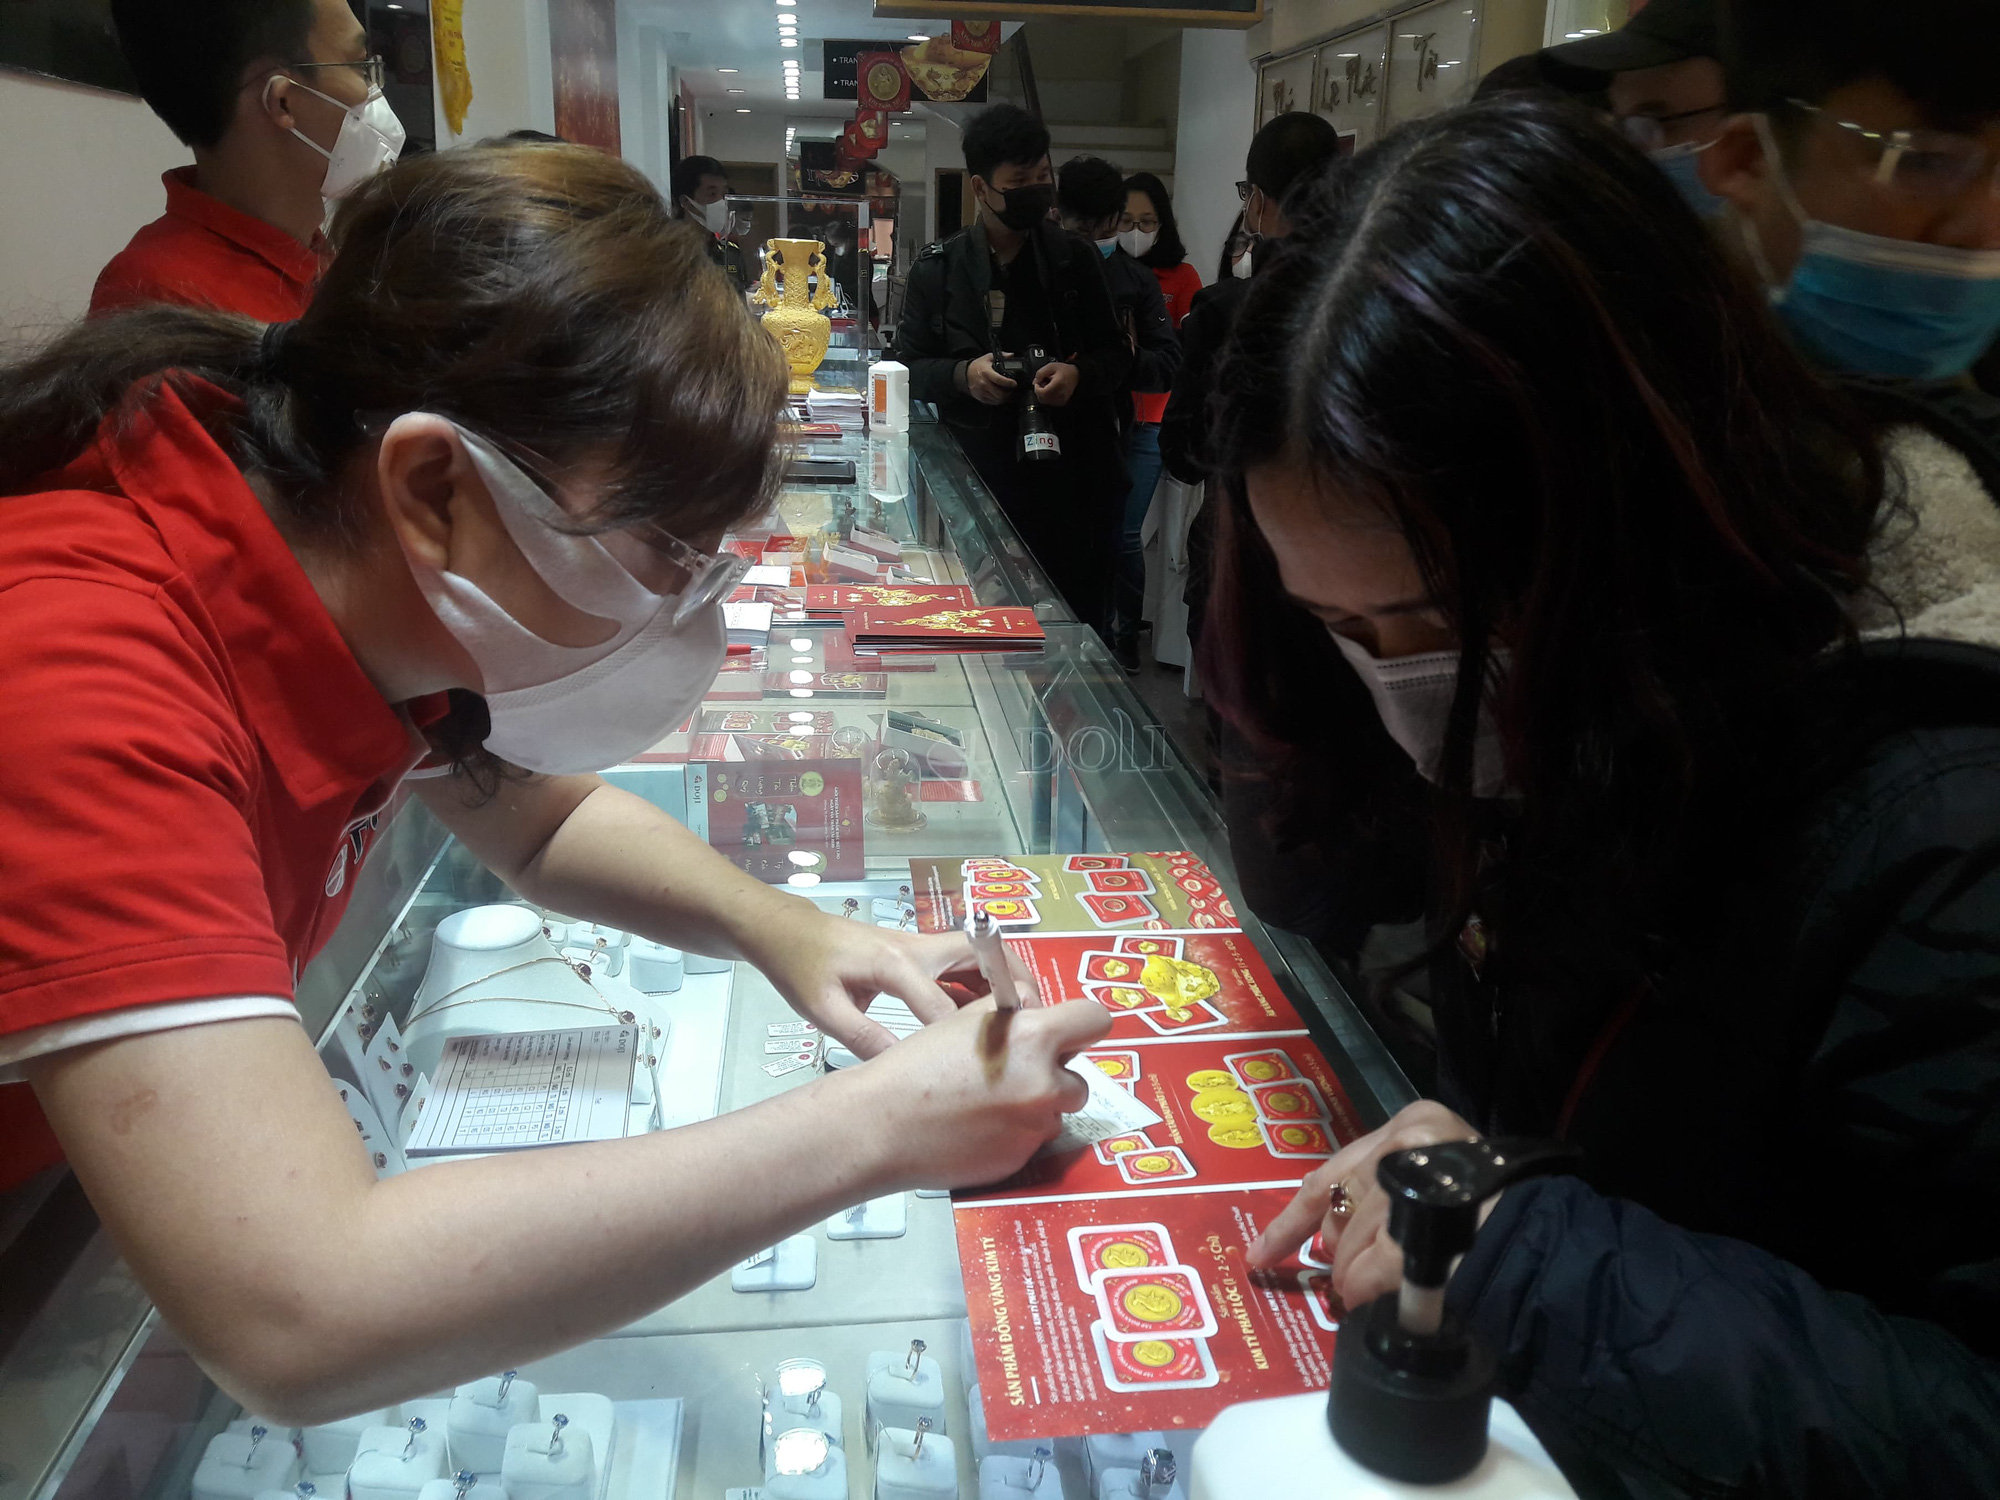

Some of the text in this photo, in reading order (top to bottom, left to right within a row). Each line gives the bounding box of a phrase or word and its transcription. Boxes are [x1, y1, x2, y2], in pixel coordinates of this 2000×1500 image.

[839, 56, 858, 64] TRAN
[840, 79, 859, 87] TRAN
[1026, 436, 1054, 449] Zing
[692, 785, 702, 804] DOJI
[615, 1037, 627, 1053] DOJI
[1225, 1286, 1244, 1307] LỘC
[979, 1236, 1025, 1406] SẢN PHẨM ĐỒNG VÀNG KIM TÝ
[1233, 1306, 1256, 1334] PHÁT
[1250, 1348, 1269, 1370] KIM
